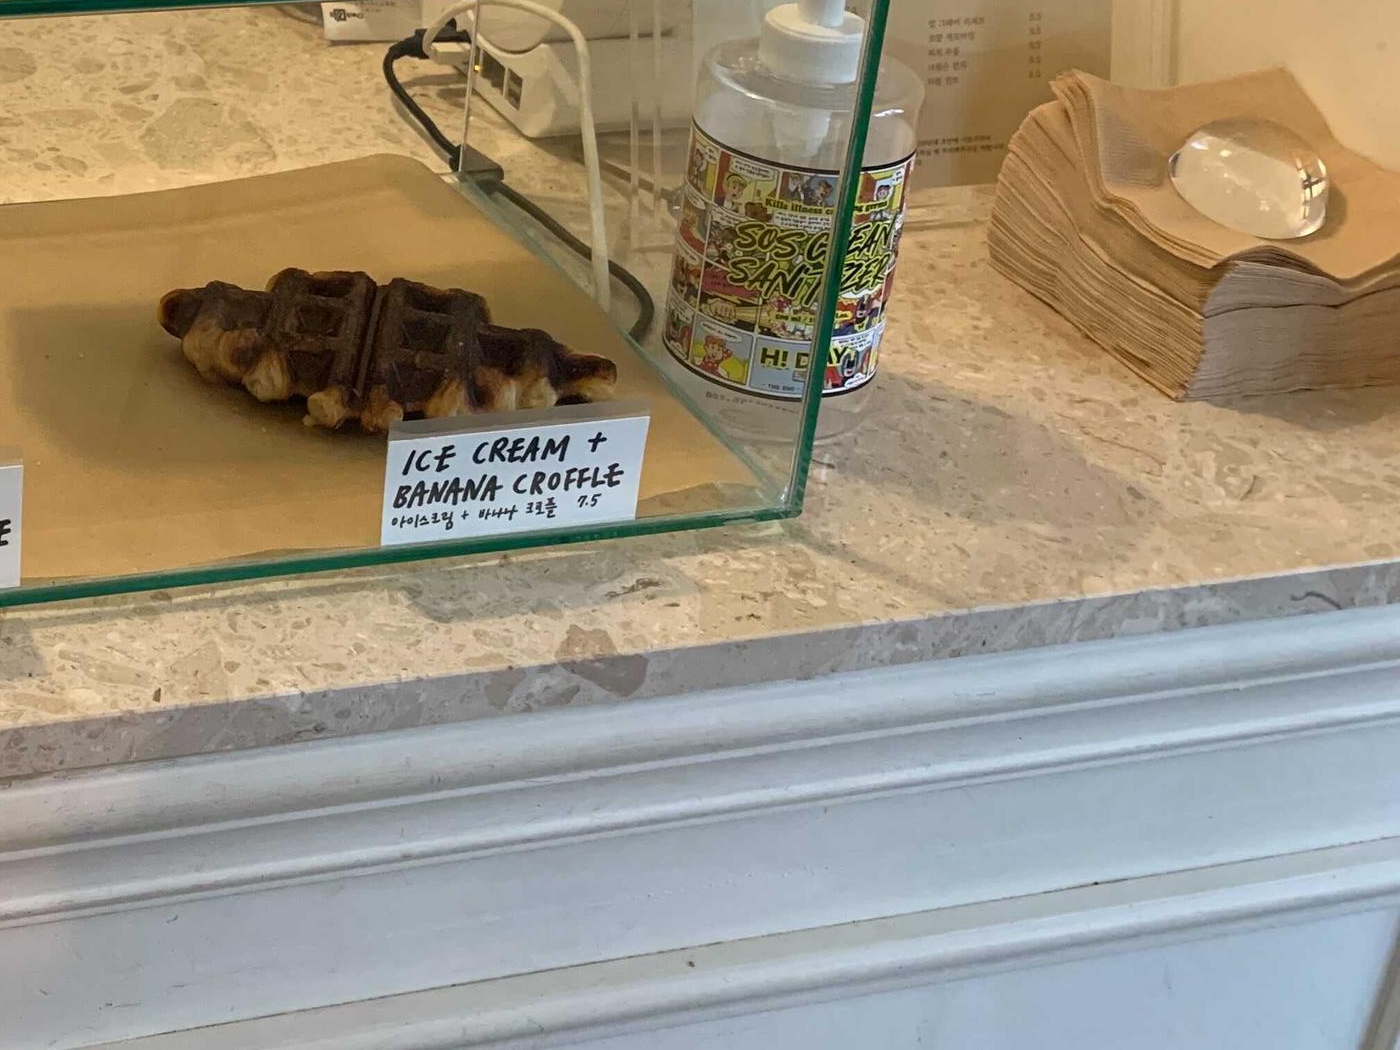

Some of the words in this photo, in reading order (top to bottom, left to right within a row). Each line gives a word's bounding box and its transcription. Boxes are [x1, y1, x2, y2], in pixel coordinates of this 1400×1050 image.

[804, 215, 896, 263] CEAN
[727, 253, 892, 309] SANITZER
[404, 444, 456, 476] ICE
[472, 434, 571, 464] CREAM
[392, 474, 504, 509] BANANA
[512, 462, 625, 496] CROFFLE
[577, 493, 603, 509] 7.5
[391, 511, 455, 531] 아이스크림
[478, 504, 518, 521] 바나나
